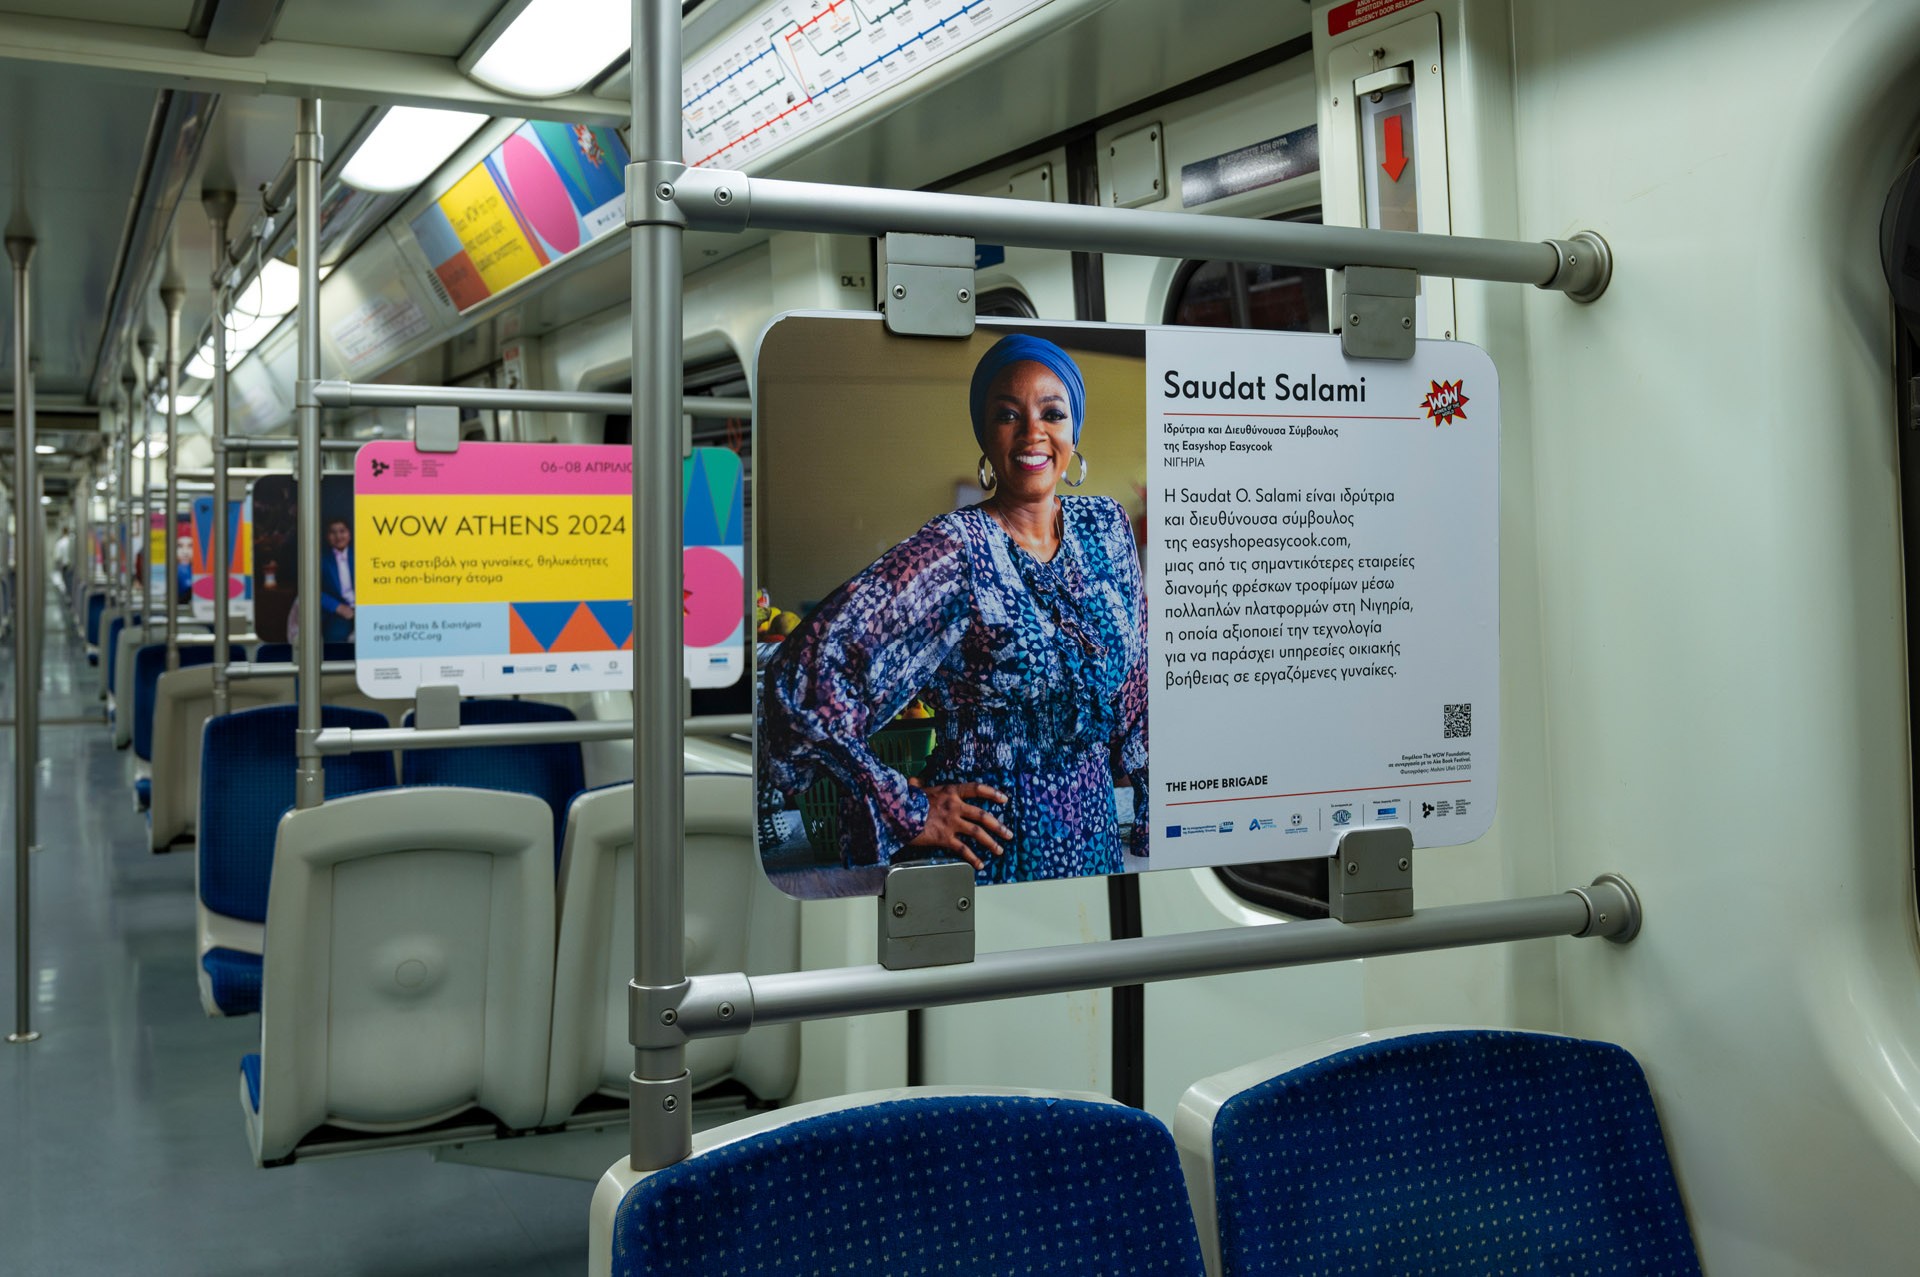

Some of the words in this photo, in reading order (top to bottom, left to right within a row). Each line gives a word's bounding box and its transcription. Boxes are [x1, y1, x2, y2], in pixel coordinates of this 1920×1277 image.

[1348, 13, 1378, 28] EMERGENCY
[1379, 5, 1395, 16] DOOR
[1395, 0, 1418, 10] RELEAS
[1165, 370, 1265, 400] Saudat
[1276, 373, 1365, 402] Salami
[1428, 386, 1458, 410] WOW
[1164, 423, 1205, 436] Ιδρύτρια
[1225, 424, 1285, 435] Διευθύνουσα
[1289, 425, 1338, 437] Σύμβουλος
[1164, 443, 1179, 453] της
[1183, 441, 1226, 453] Easyshop
[1230, 441, 1272, 453] Easycook
[1164, 457, 1205, 467] ΝΙΓΗΡΙΑ
[1165, 489, 1175, 502] Η
[1181, 488, 1231, 502] Saudat
[1236, 488, 1250, 502] O.
[1256, 488, 1301, 502] Salami
[1306, 488, 1335, 502] είναι
[1341, 488, 1394, 505] ιδρύτρια
[372, 516, 447, 536] WOW
[456, 515, 558, 535] ATHENS
[569, 515, 626, 535] 2024
[1165, 516, 1184, 526] και
[1190, 511, 1277, 525] διευθύνουσα
[1283, 510, 1354, 528] σύμβουλος
[1164, 539, 1187, 552] της
[1192, 532, 1350, 552] easyshopeasycook.com,
[400, 556, 456, 570] φεστιβάλ
[460, 560, 477, 570] για
[537, 555, 608, 568] θηλυκότητες
[1165, 562, 1193, 576] μιας
[1199, 557, 1225, 571] από
[1229, 561, 1246, 573] τις
[1252, 555, 1353, 573] σημαντικότερες
[1358, 554, 1414, 571] εταιρείες
[373, 576, 391, 584] και
[395, 572, 462, 586] non-binary
[466, 572, 503, 585] άτομα
[1165, 580, 1227, 598] διανομής
[1232, 579, 1292, 597] φρέσκων
[1295, 577, 1357, 595] τροφίμων
[1362, 576, 1394, 593] μέσω
[1166, 602, 1240, 618] πολλαπλών
[1246, 600, 1328, 618] πλατφορμών
[1333, 603, 1355, 615] στη
[1361, 597, 1413, 615] Νιγηρία,
[373, 622, 407, 630] Festival
[410, 621, 429, 630] Pass
[432, 621, 439, 629] &
[1166, 632, 1173, 644] η
[1179, 626, 1217, 640] οποία
[1223, 623, 1283, 641] αξιοποιεί
[1287, 627, 1309, 639] την
[1313, 620, 1381, 638] τεχνολογία
[393, 631, 442, 642] SNFCC.org
[1165, 653, 1185, 667] για
[1190, 652, 1206, 661] να
[1212, 646, 1274, 664] παράσχει
[1280, 643, 1344, 661] υπηρεσίες
[1349, 641, 1400, 657] οικιακής
[1166, 670, 1229, 690] βοήθειας
[1234, 673, 1249, 682] σε
[1255, 666, 1336, 685] εργαζόμενες
[1341, 662, 1396, 681] γυναίκες.
[1166, 782, 1186, 792] THE
[1190, 779, 1219, 790] HOPE
[1222, 775, 1268, 788] BRIGADE
